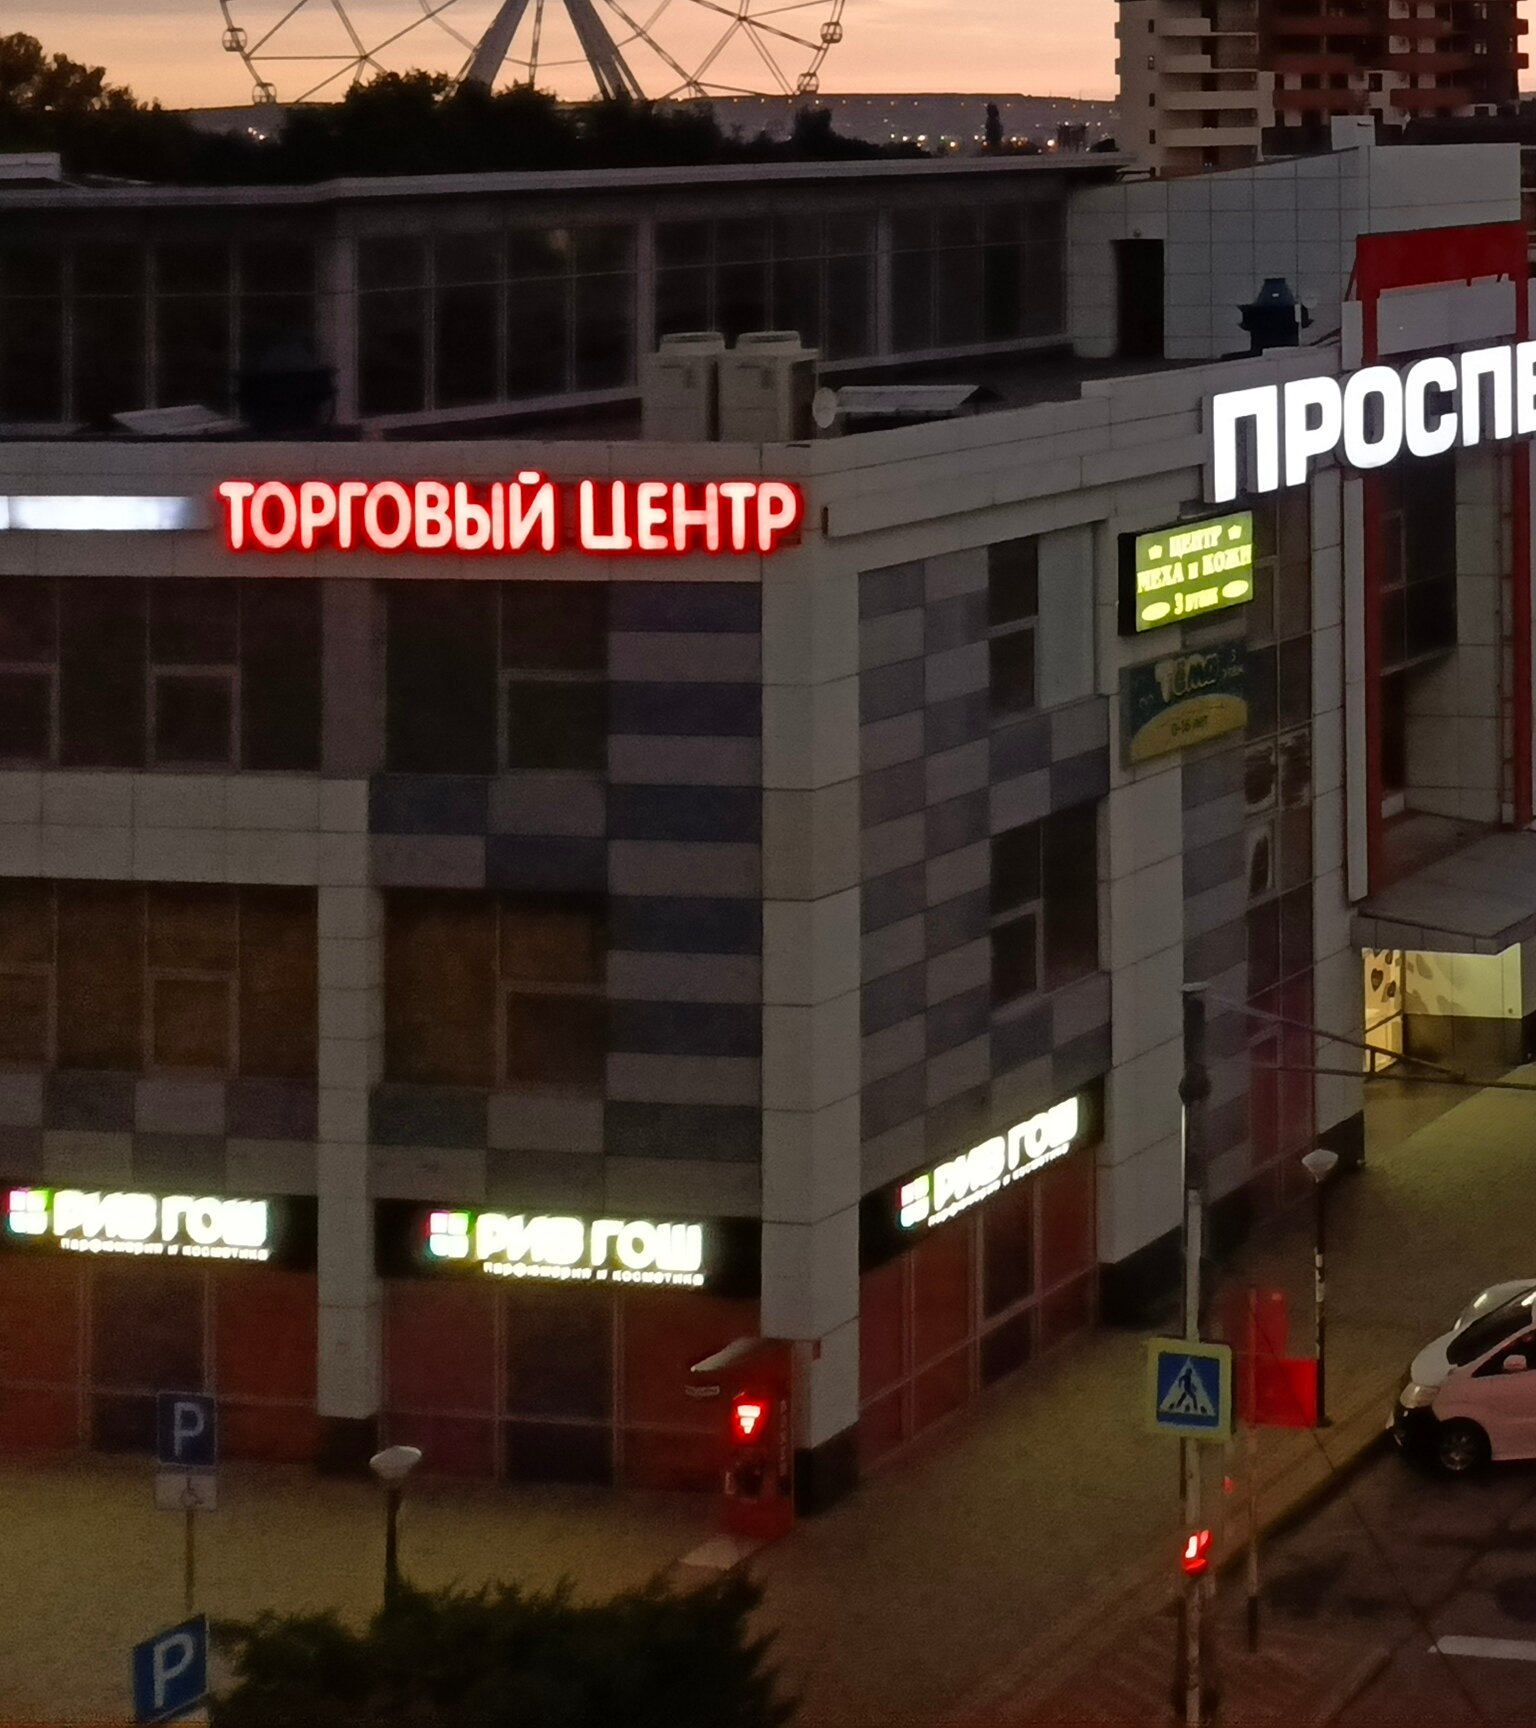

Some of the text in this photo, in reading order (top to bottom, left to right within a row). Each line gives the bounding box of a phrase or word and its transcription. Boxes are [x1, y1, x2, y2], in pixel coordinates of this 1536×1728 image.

[219, 472, 799, 553] ТОРГОВЫЙ ЦЕНТР
[53, 1189, 268, 1247] РИВ ГОШ
[475, 1213, 703, 1272] РИВ ГОШ
[152, 1633, 196, 1709] P
